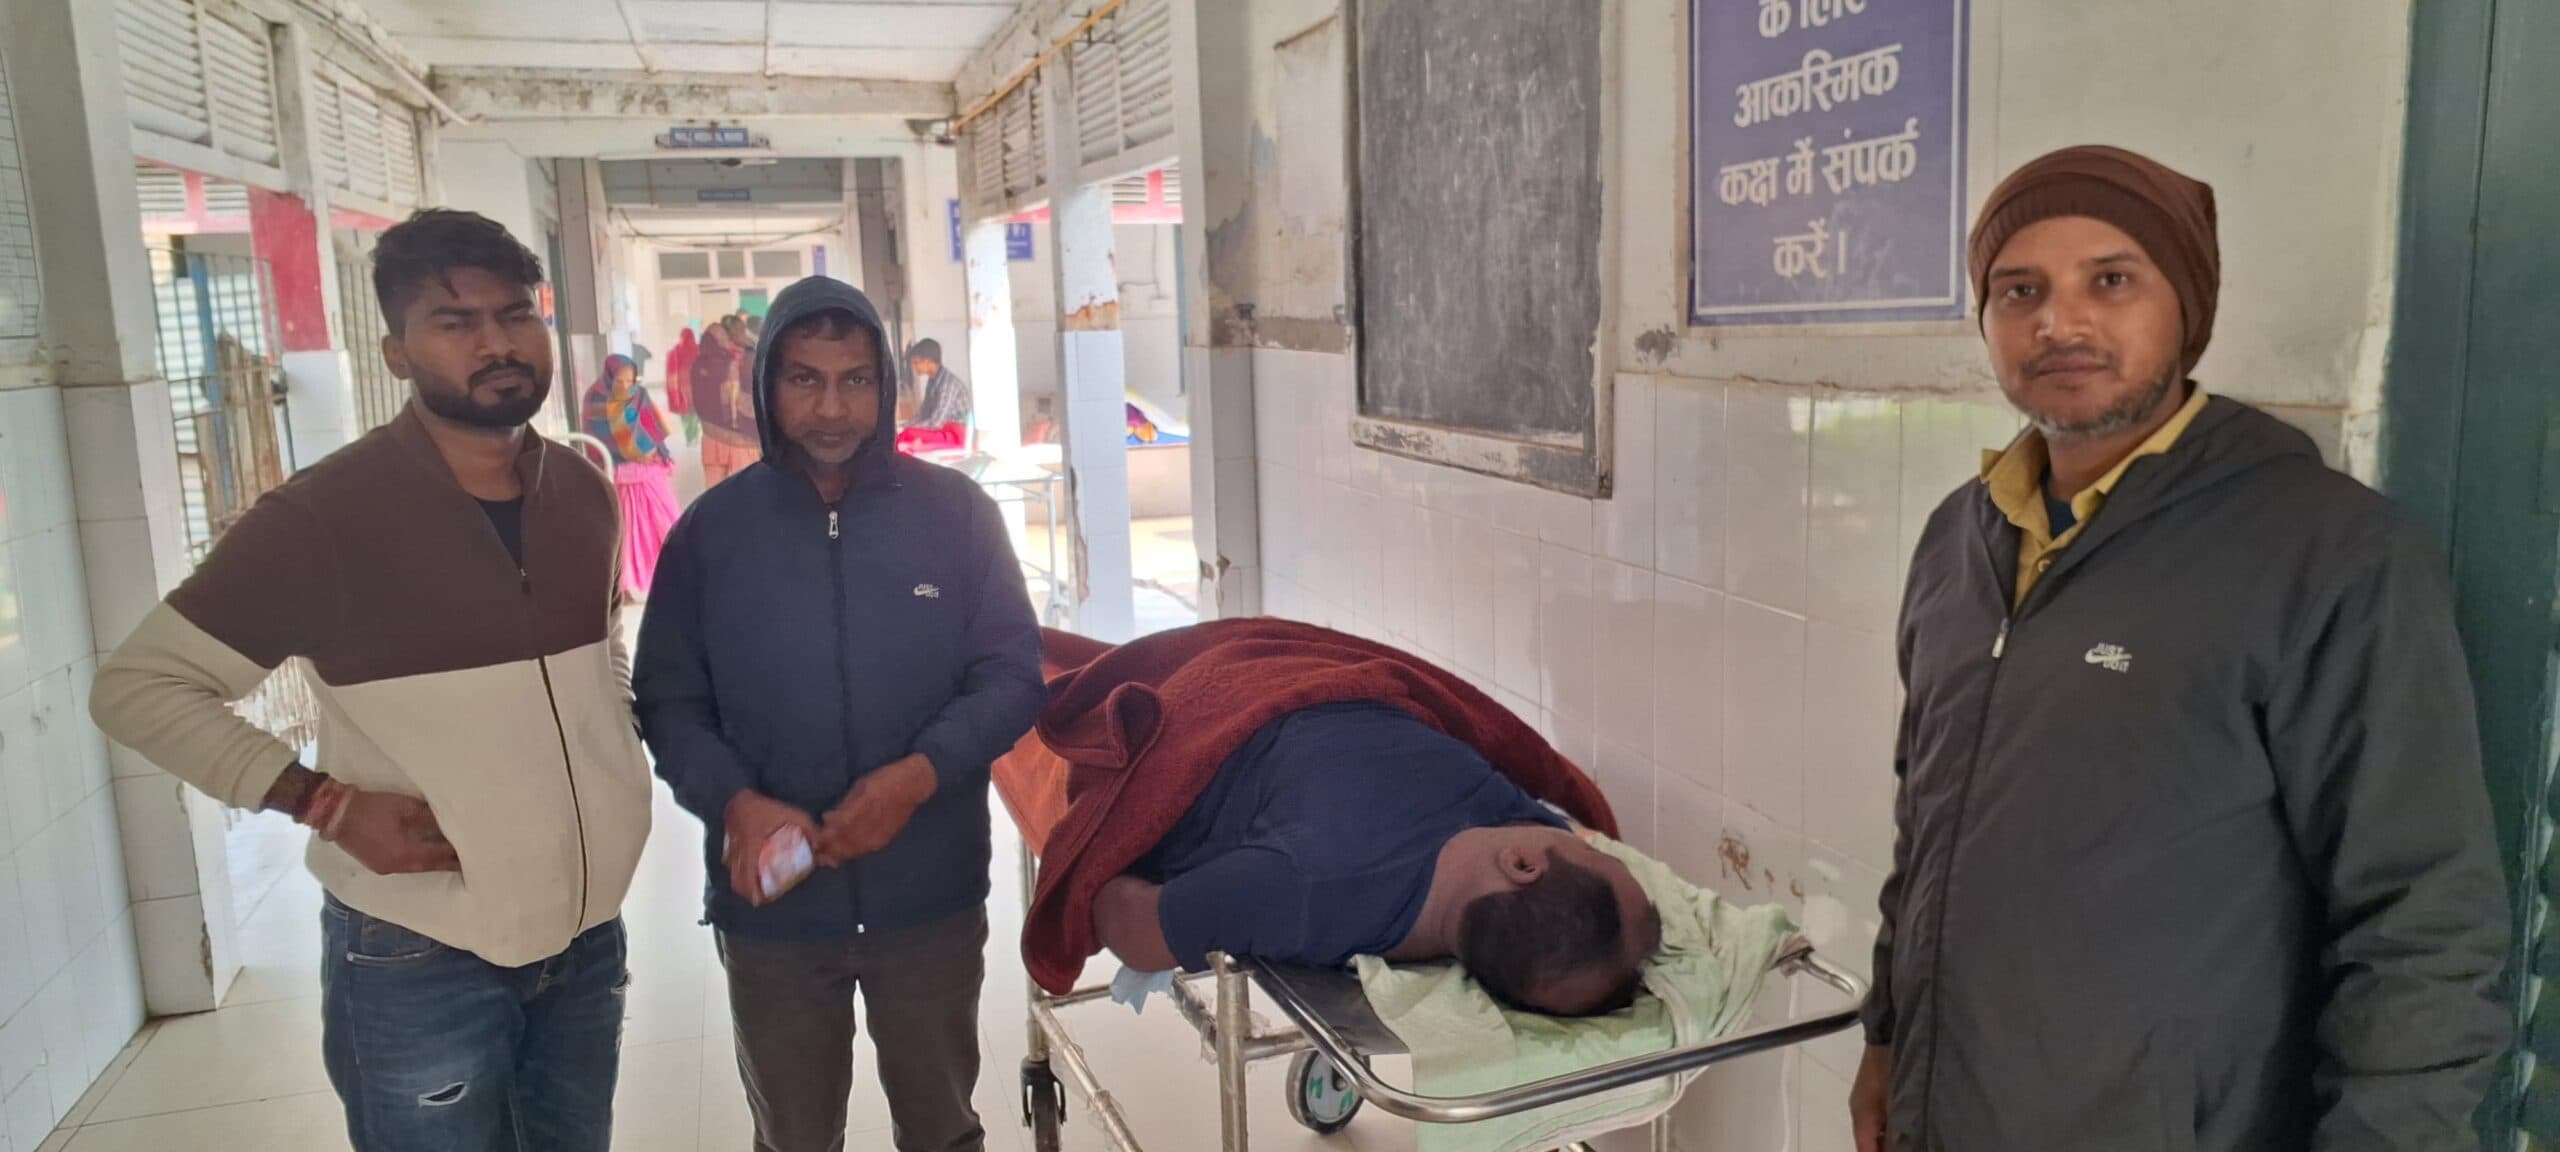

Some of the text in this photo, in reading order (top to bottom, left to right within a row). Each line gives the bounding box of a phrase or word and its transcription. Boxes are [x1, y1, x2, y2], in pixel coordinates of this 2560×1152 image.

[1758, 0, 1792, 38] क
[1734, 43, 1902, 128] आकस्मिक
[1719, 117, 1920, 207] कक्ष में संपर्क
